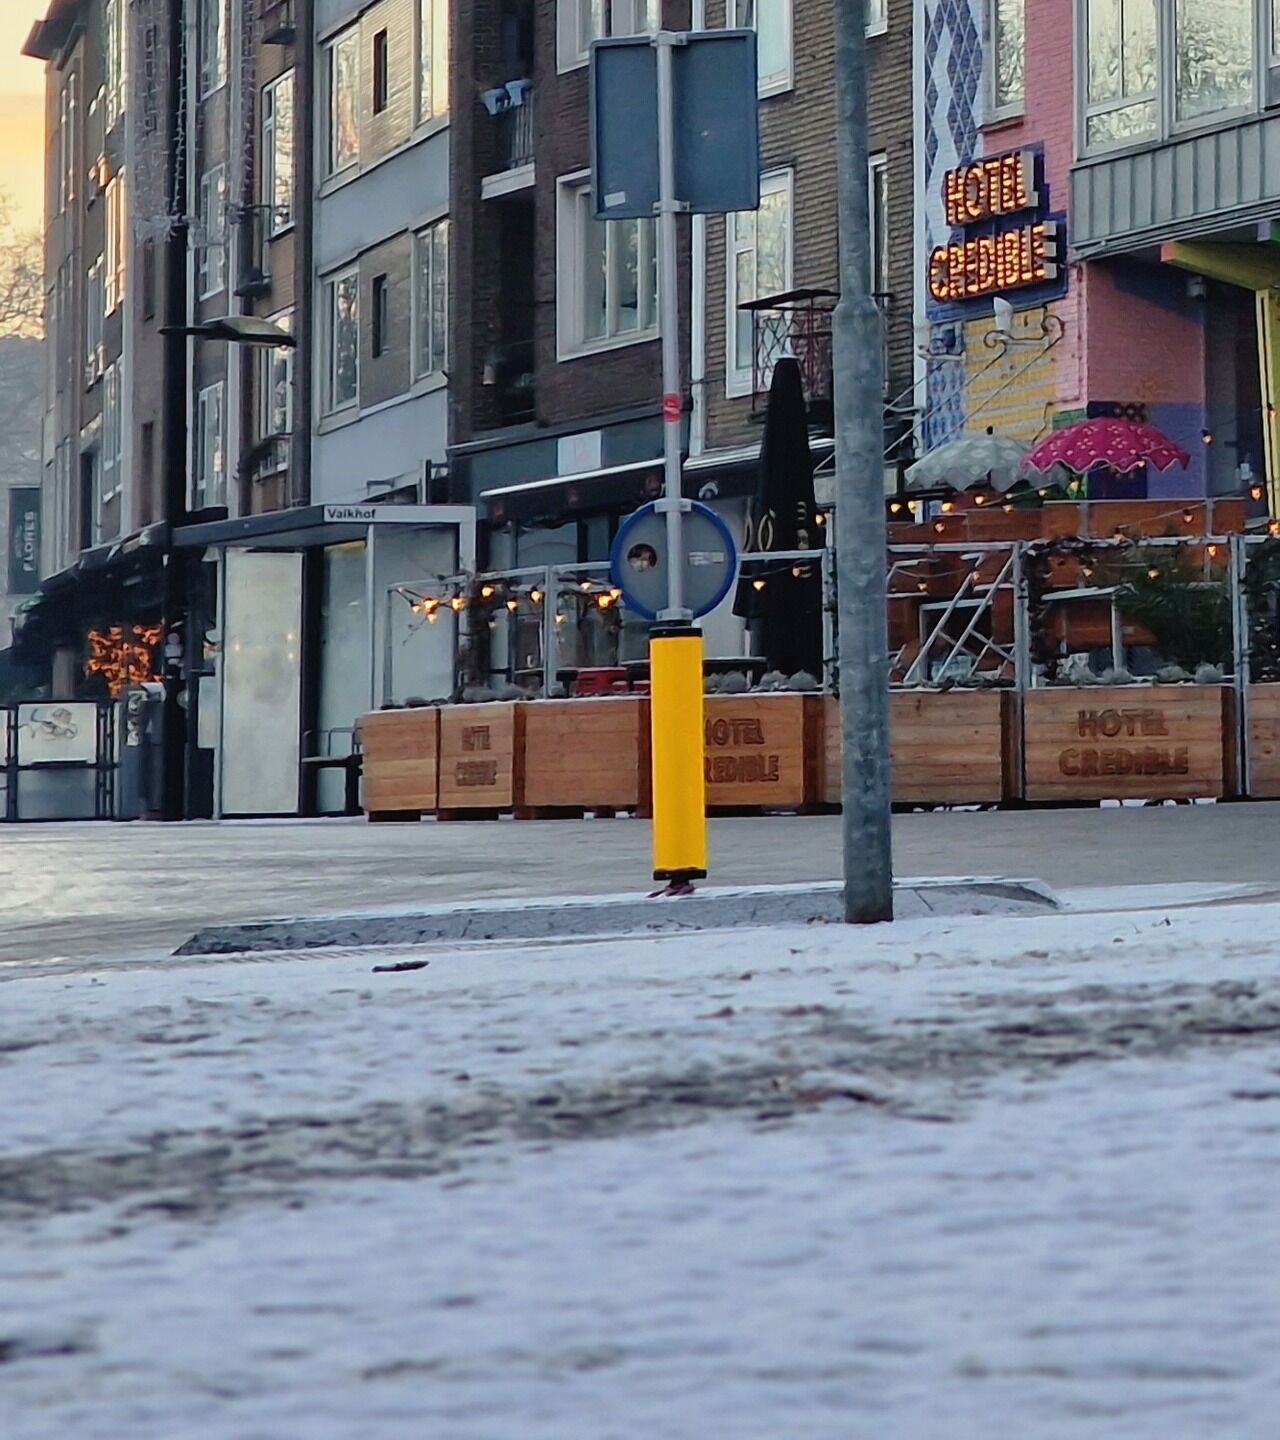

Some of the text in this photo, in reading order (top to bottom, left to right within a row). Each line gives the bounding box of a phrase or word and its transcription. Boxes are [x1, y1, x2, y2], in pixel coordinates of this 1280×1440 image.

[943, 151, 1037, 225] HOTEL
[929, 223, 1055, 302] CREDIBLE
[327, 507, 377, 520] Valkhof
[1077, 709, 1170, 739] HOTEL
[1059, 746, 1189, 776] CREDIBLE
